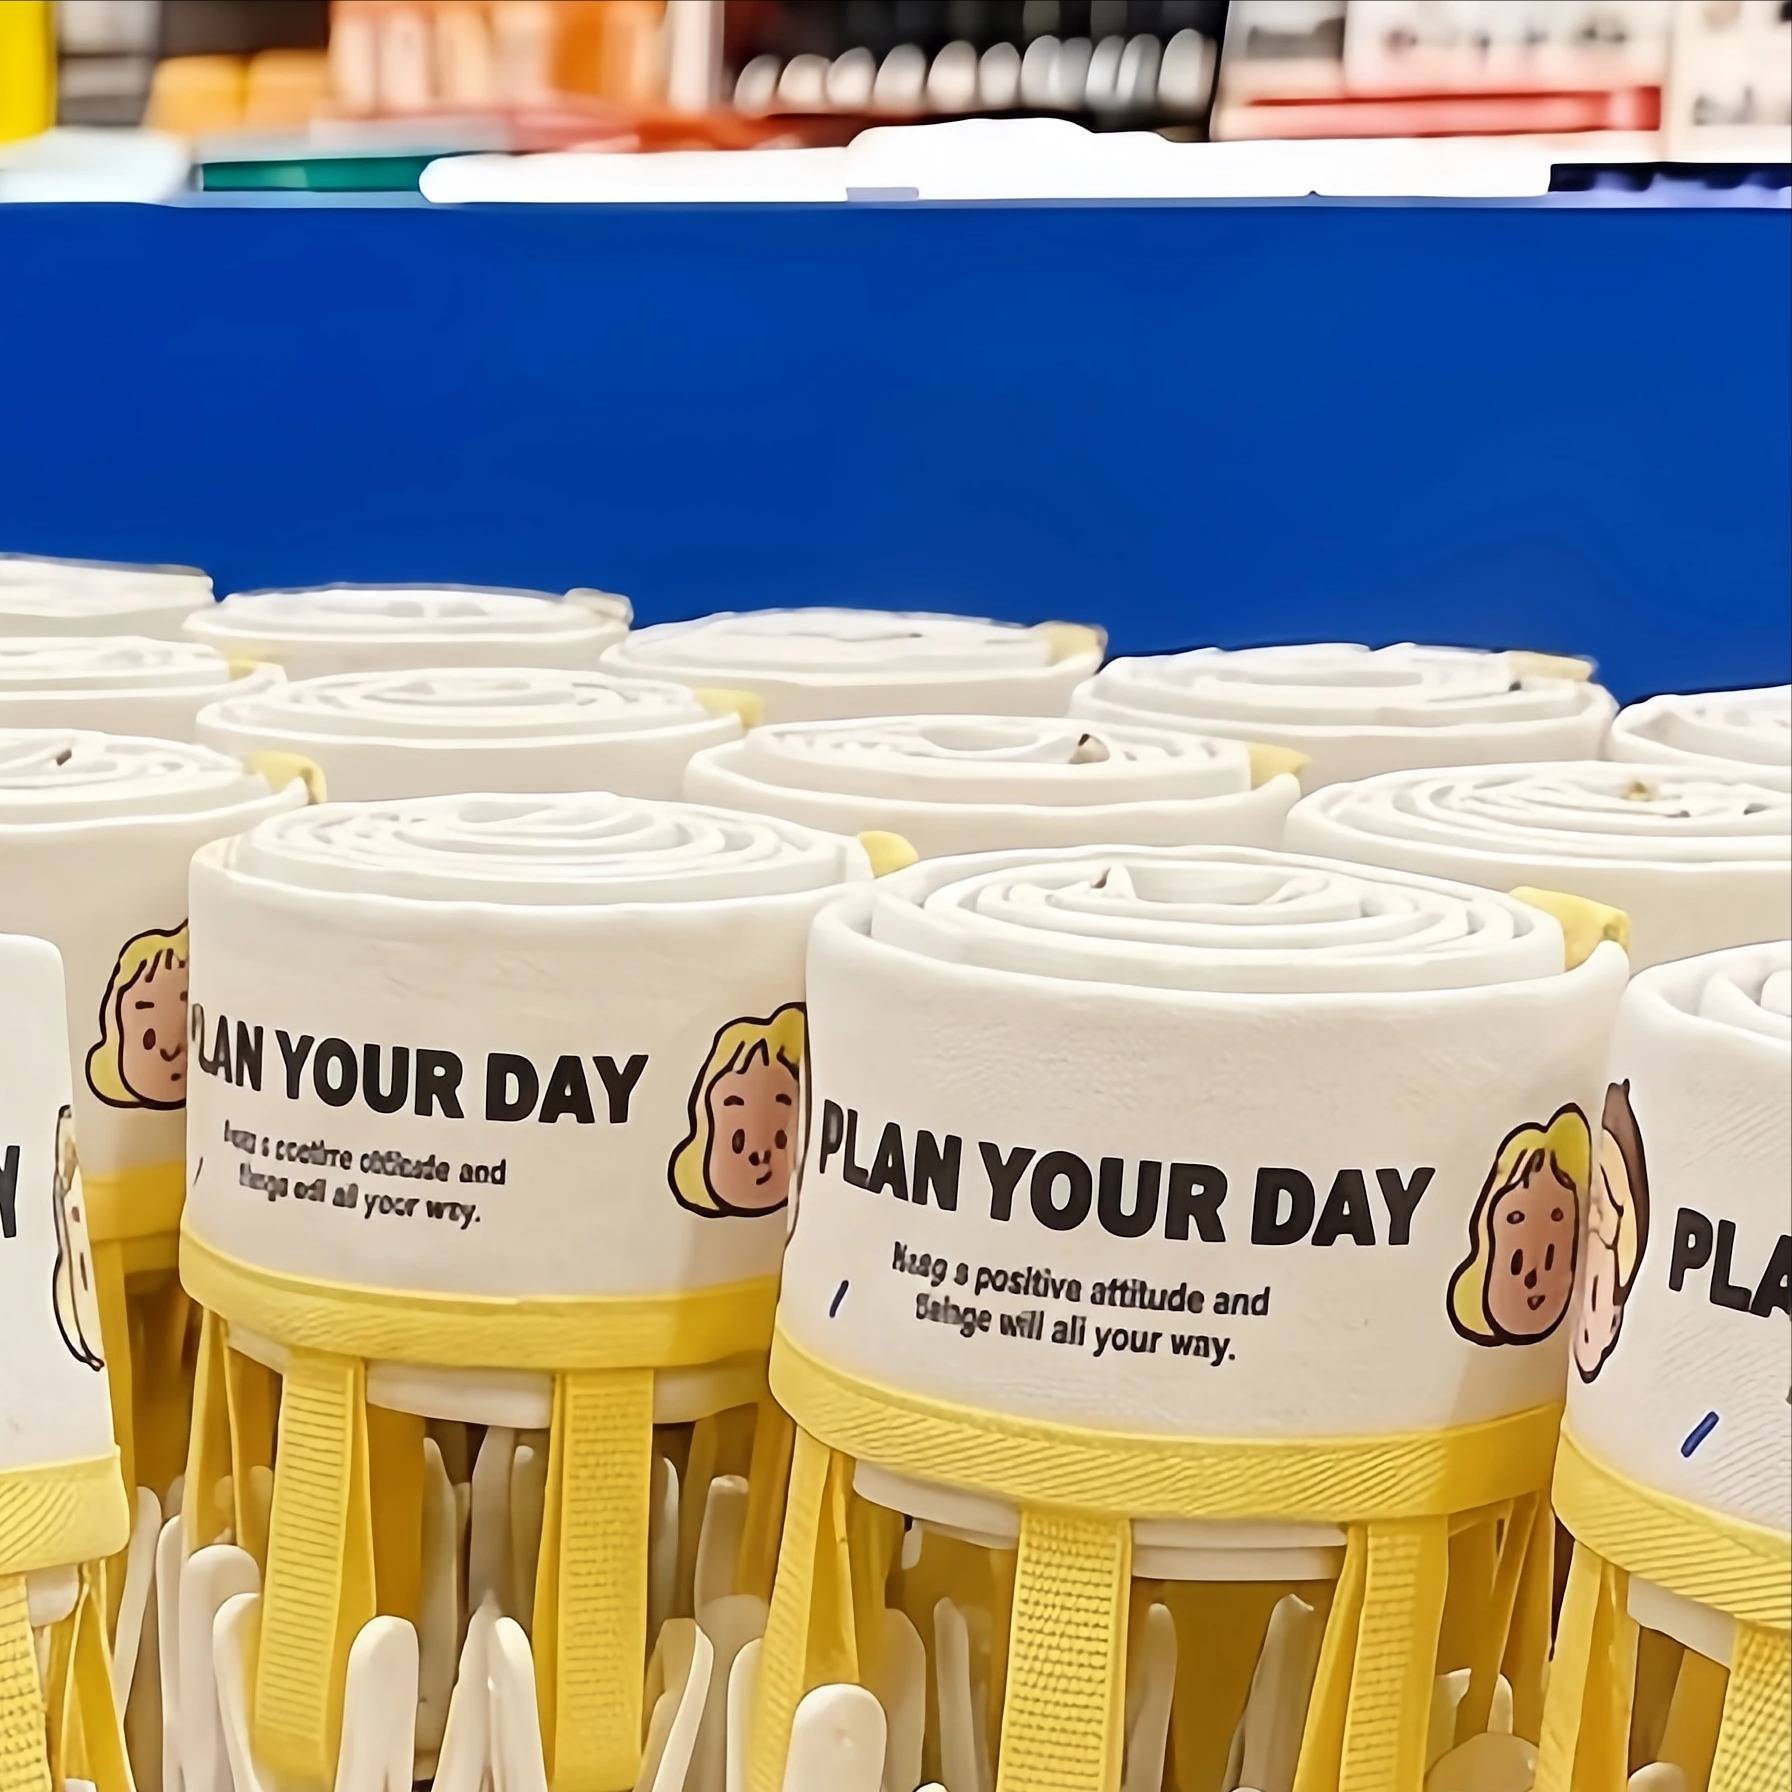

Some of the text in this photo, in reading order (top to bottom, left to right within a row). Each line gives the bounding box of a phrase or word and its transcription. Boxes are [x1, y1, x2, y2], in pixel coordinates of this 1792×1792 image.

[274, 1029, 465, 1119] YOUR
[485, 1053, 649, 1124] DAY
[818, 1100, 1436, 1247] PLAN YOUR DAY
[1213, 1286, 1271, 1316] and
[1092, 1326, 1163, 1358] your
